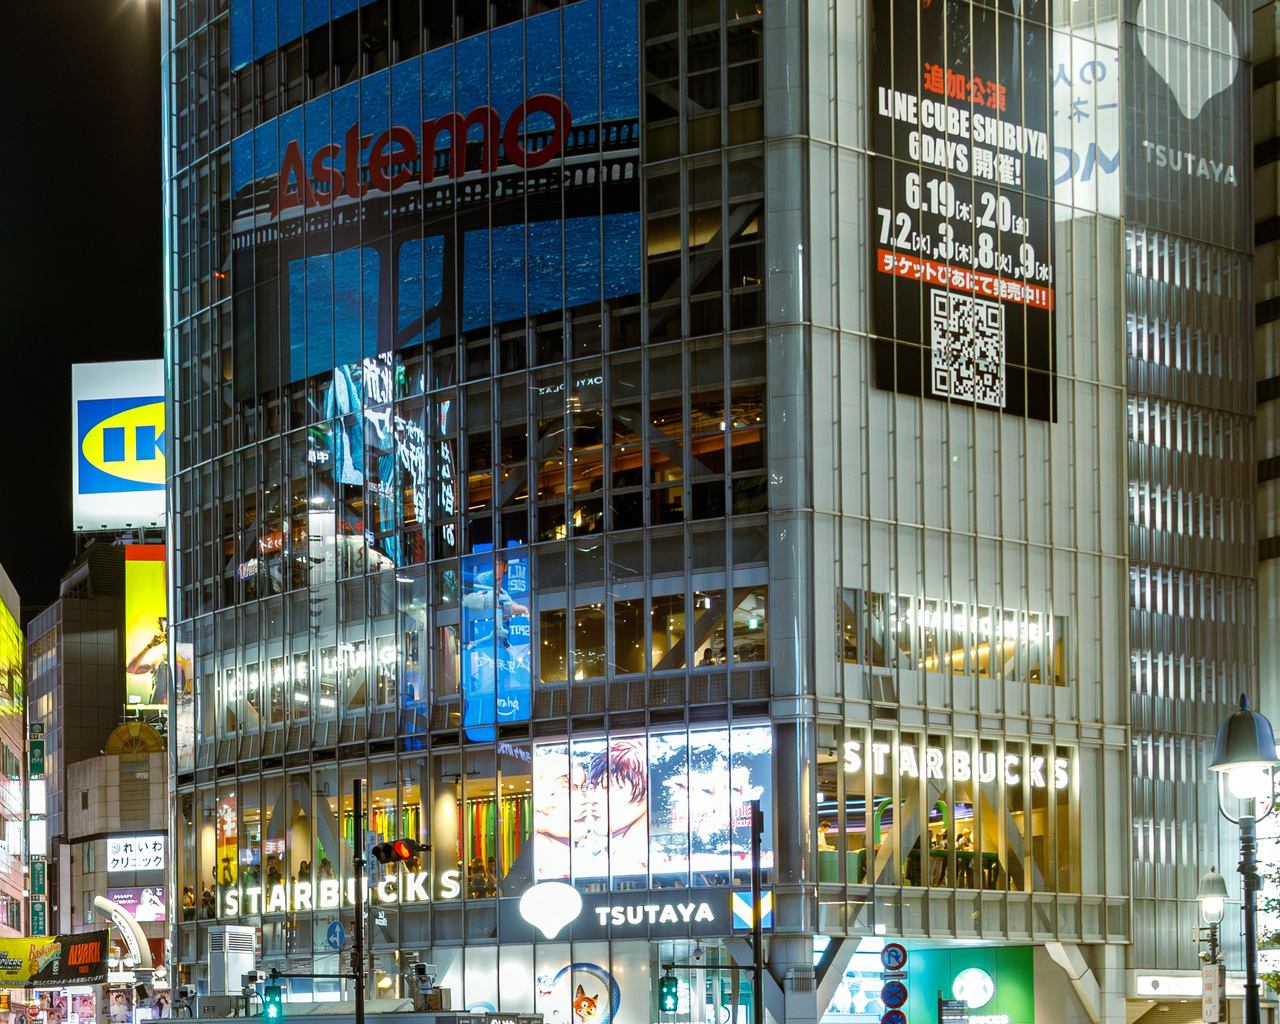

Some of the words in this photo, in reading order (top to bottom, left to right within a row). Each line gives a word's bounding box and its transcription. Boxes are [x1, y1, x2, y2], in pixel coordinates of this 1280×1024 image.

[923, 62, 1007, 111] 追加公演
[878, 87, 918, 124] LINE
[921, 99, 970, 138] CUBE
[972, 112, 1049, 160] SHIBUYA
[271, 93, 573, 220] Astemo
[908, 131, 969, 174] 6DAYS
[971, 147, 1022, 186] 開催!
[1142, 140, 1239, 187] TSUTAYA
[843, 740, 1070, 789] STARBUCKS
[110, 857, 163, 869] クリニック
[123, 840, 163, 854] れいわ
[225, 868, 462, 917] STARBUCKS
[595, 902, 715, 926] TSUTAYA
[1203, 968, 1212, 1017] 公園通り
